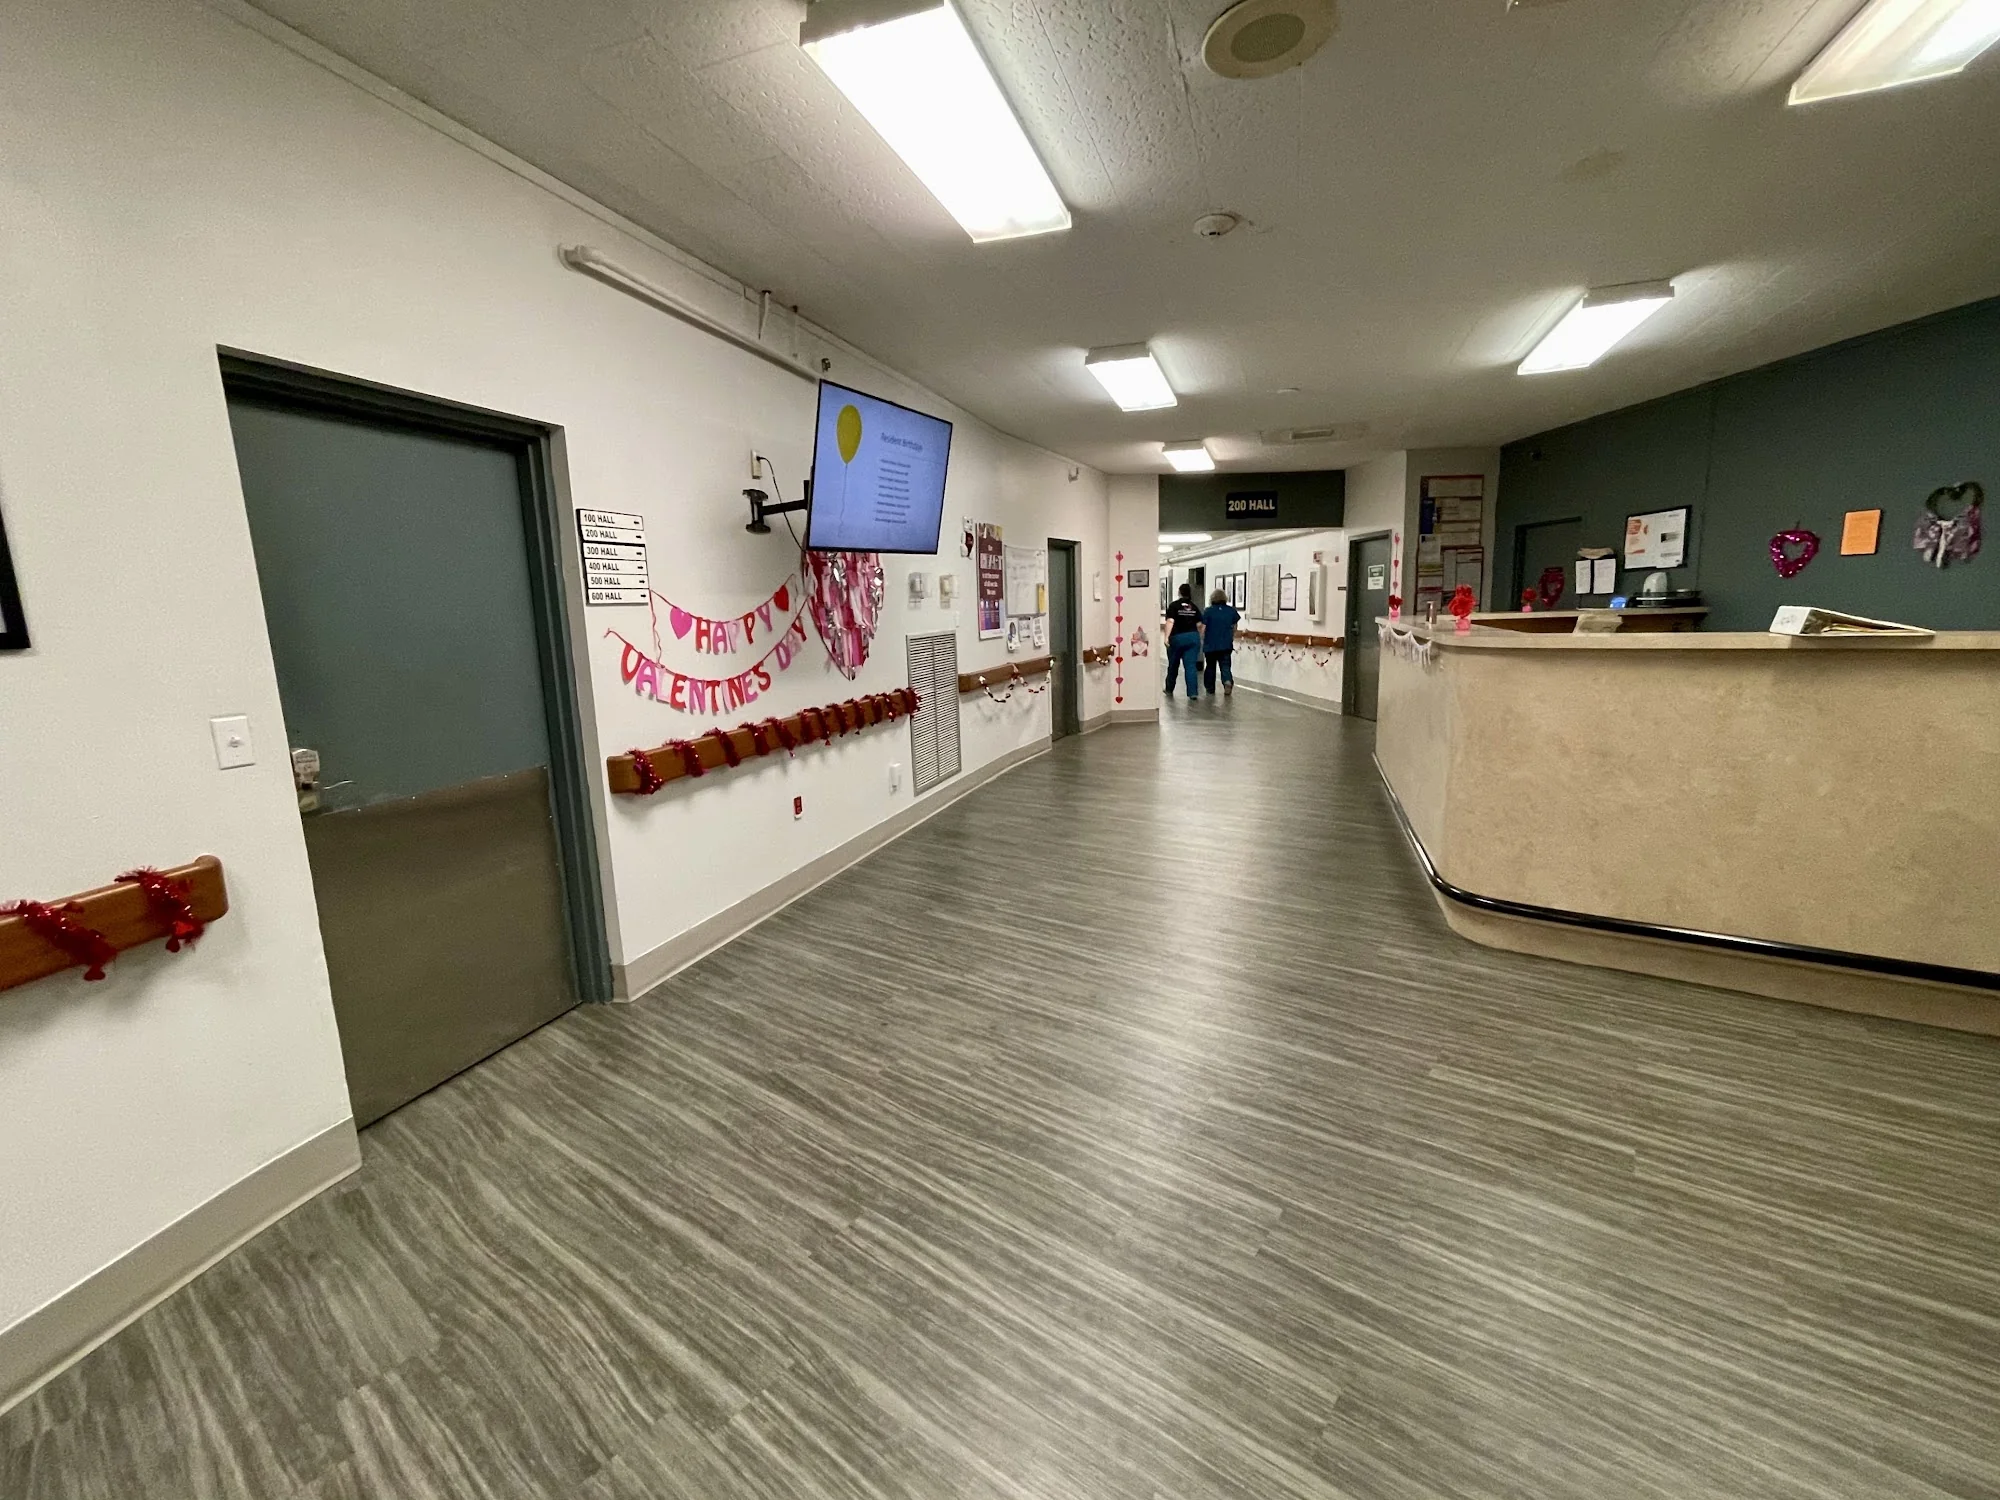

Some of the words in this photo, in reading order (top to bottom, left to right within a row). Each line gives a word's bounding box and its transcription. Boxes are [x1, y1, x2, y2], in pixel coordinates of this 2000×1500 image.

[1228, 500, 1246, 511] 200
[1249, 499, 1275, 510] HALL
[584, 514, 596, 523] 100
[597, 514, 615, 524] HALL
[585, 529, 598, 538] 200
[600, 530, 617, 539] HALL
[586, 546, 599, 555] 300
[600, 547, 618, 556] HALL
[589, 562, 601, 571] 400
[602, 562, 619, 571] HALL
[590, 576, 602, 585] 500
[603, 577, 621, 585] HALL
[591, 592, 604, 600] 600
[605, 592, 622, 600] HALL
[695, 604, 772, 655] HAPPY
[620, 643, 771, 715] VALENTINES
[775, 616, 807, 671] DAY
